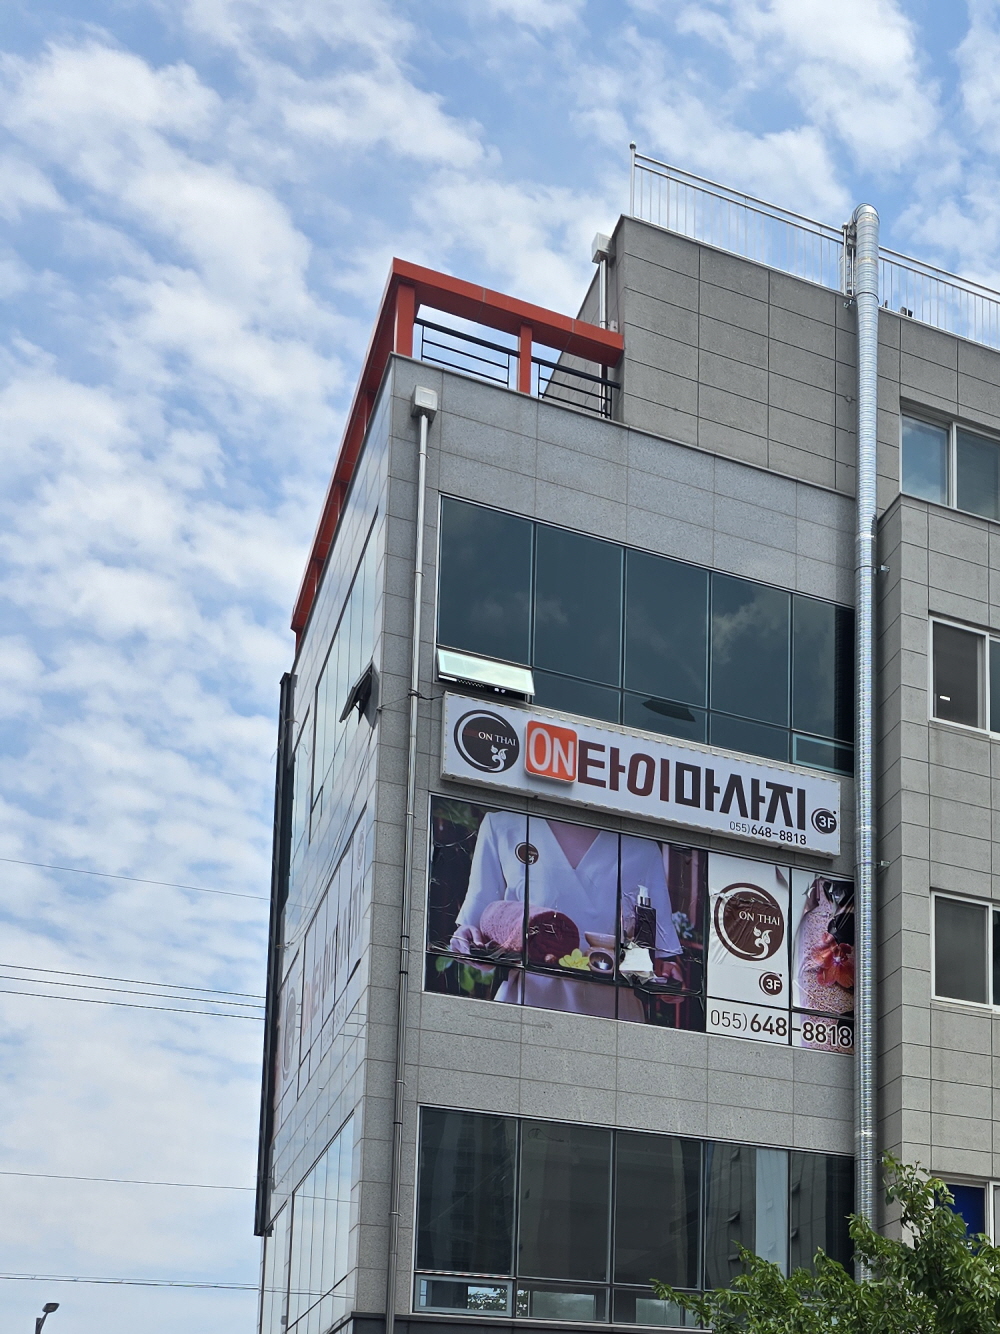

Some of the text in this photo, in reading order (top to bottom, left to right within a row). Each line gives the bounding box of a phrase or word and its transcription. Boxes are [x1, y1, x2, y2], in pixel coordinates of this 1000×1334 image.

[478, 731, 516, 747] ON THAI
[818, 815, 835, 829] 3F
[738, 910, 781, 926] ON THAI
[765, 978, 781, 991] 3F
